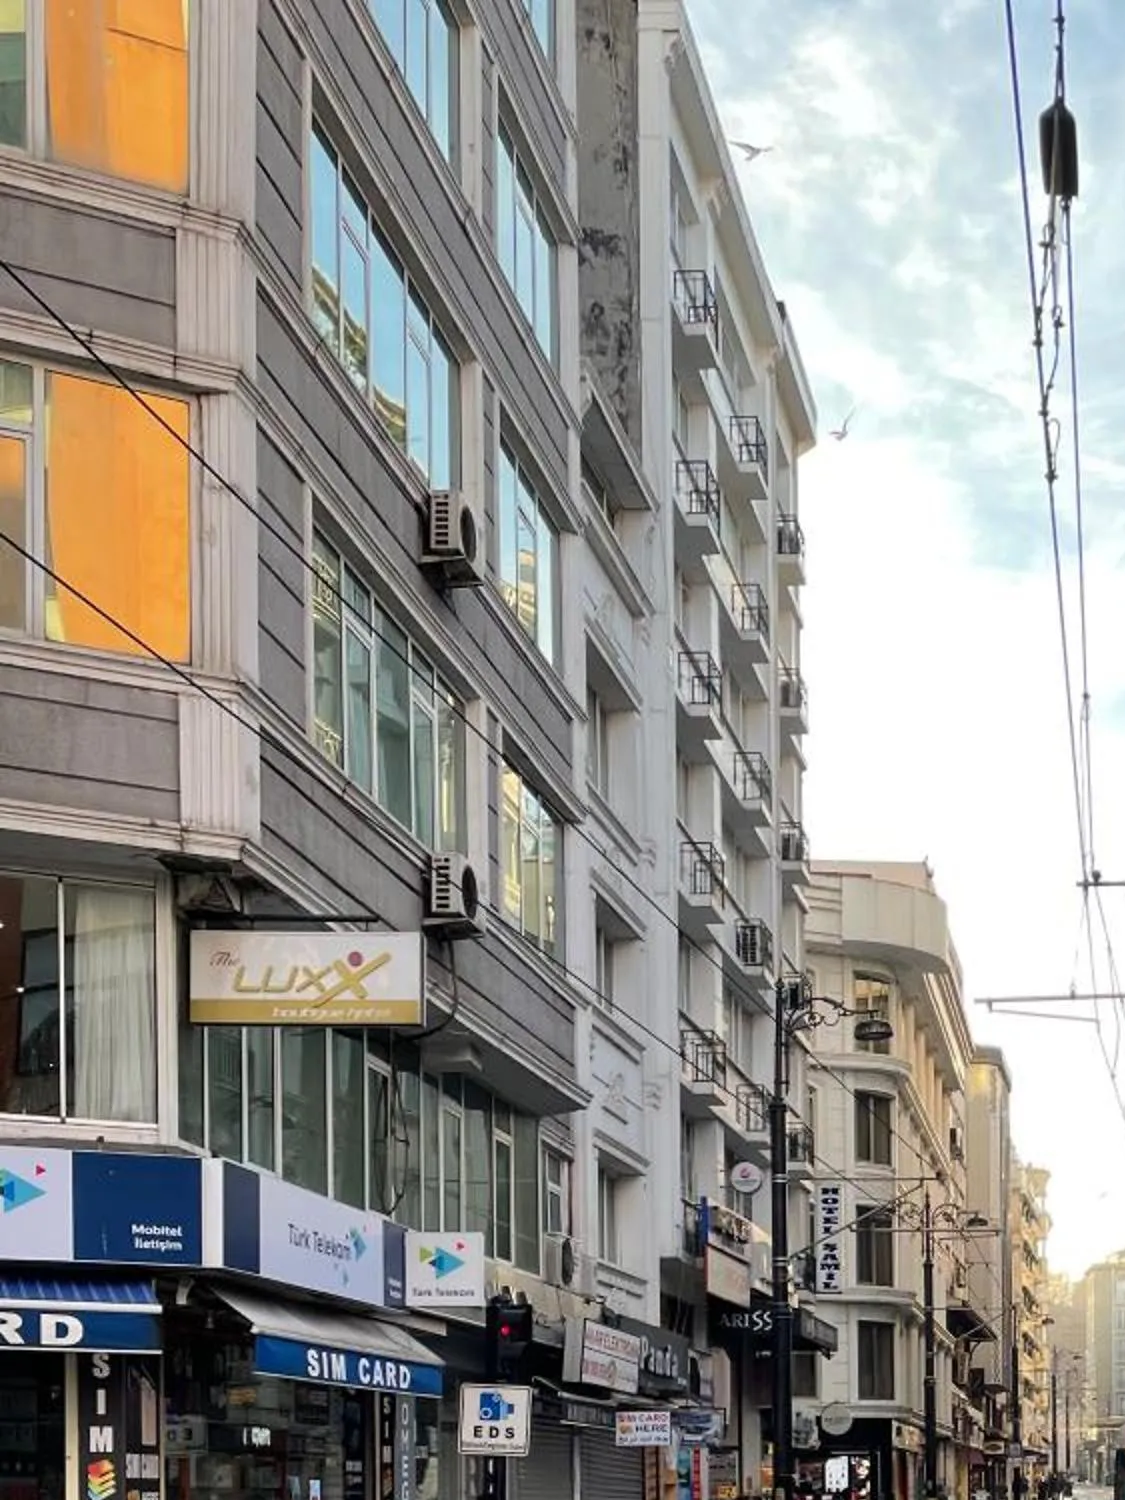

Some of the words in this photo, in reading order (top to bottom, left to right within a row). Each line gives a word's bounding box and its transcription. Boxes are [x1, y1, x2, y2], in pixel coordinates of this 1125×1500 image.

[131, 1224, 182, 1237] Mobitel
[287, 1223, 311, 1250] Türk
[312, 1231, 352, 1261] Telekom
[306, 1348, 347, 1381] SIM
[358, 1357, 412, 1389] CARD
[89, 1352, 114, 1453] SIM
